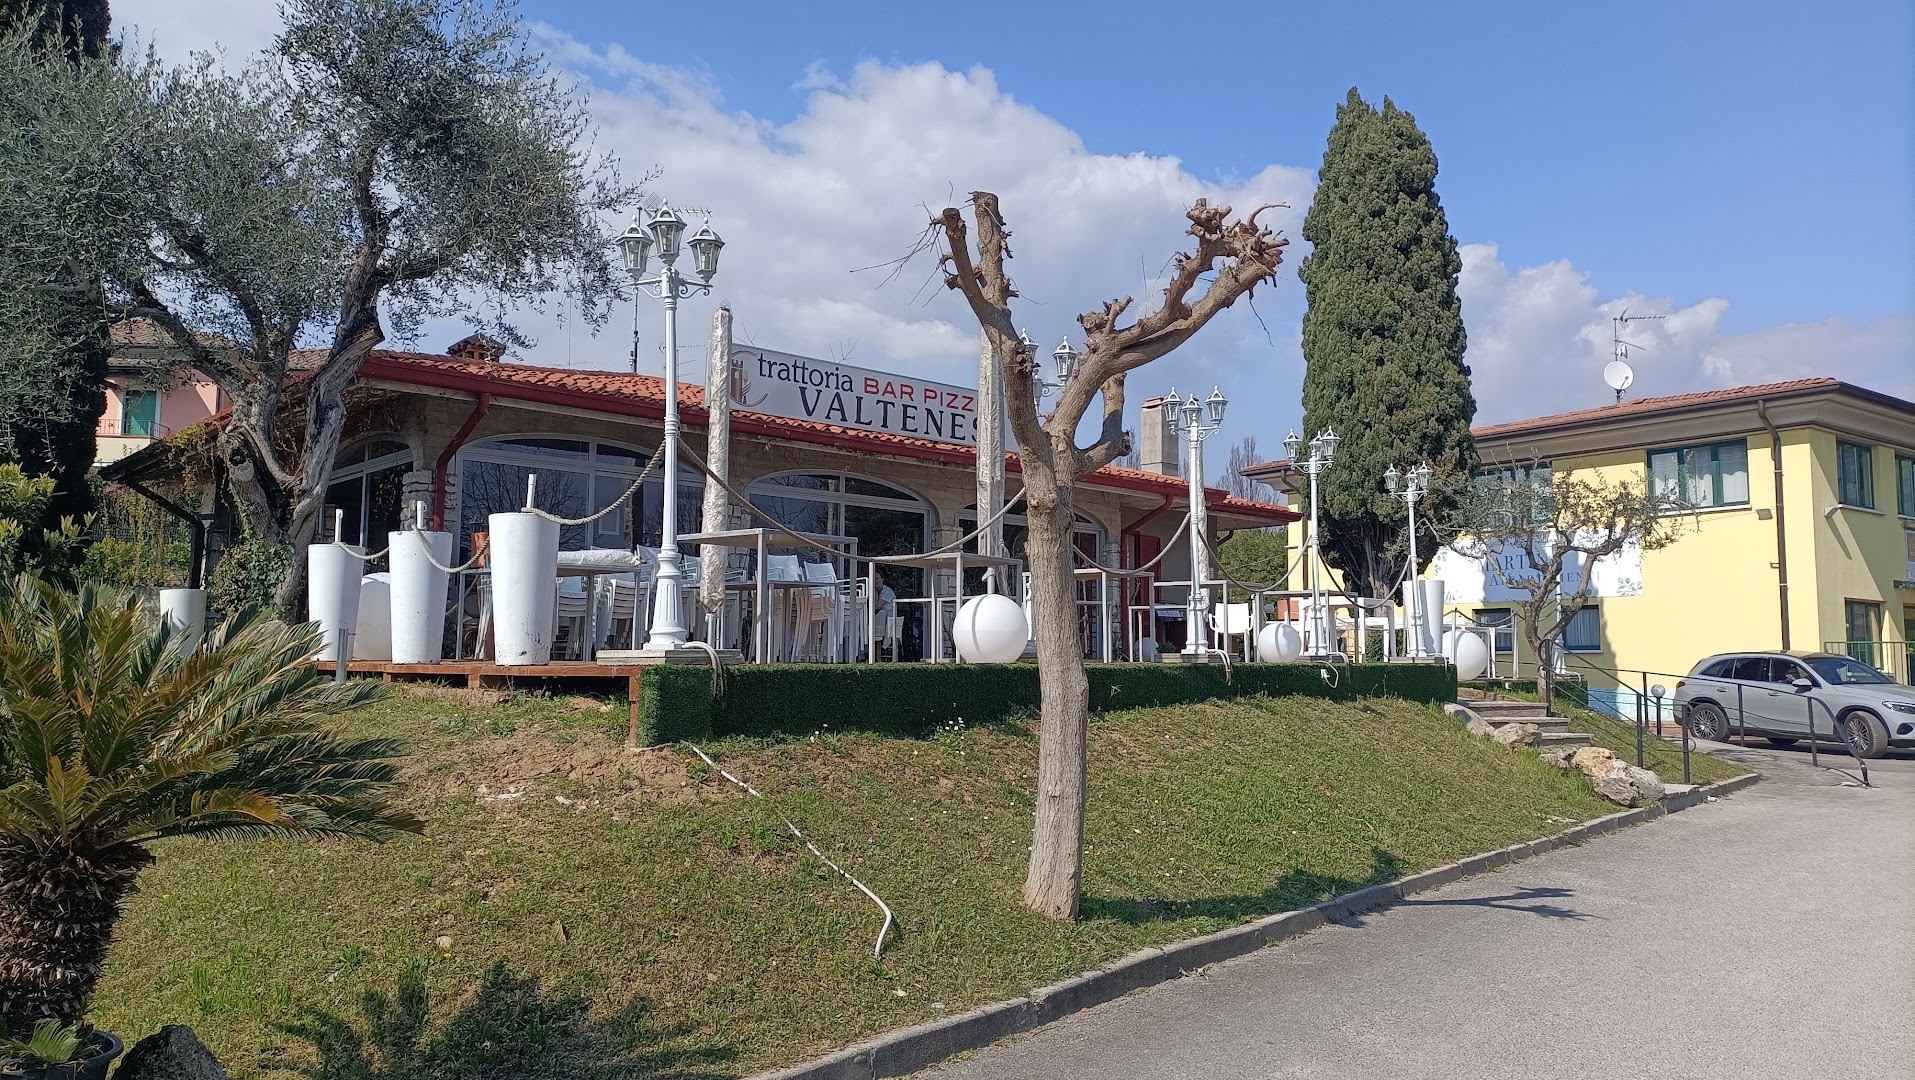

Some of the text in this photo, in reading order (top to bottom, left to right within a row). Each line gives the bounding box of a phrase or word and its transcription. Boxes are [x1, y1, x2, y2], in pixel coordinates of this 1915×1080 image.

[757, 352, 975, 412] trattoria BAR PIZZ
